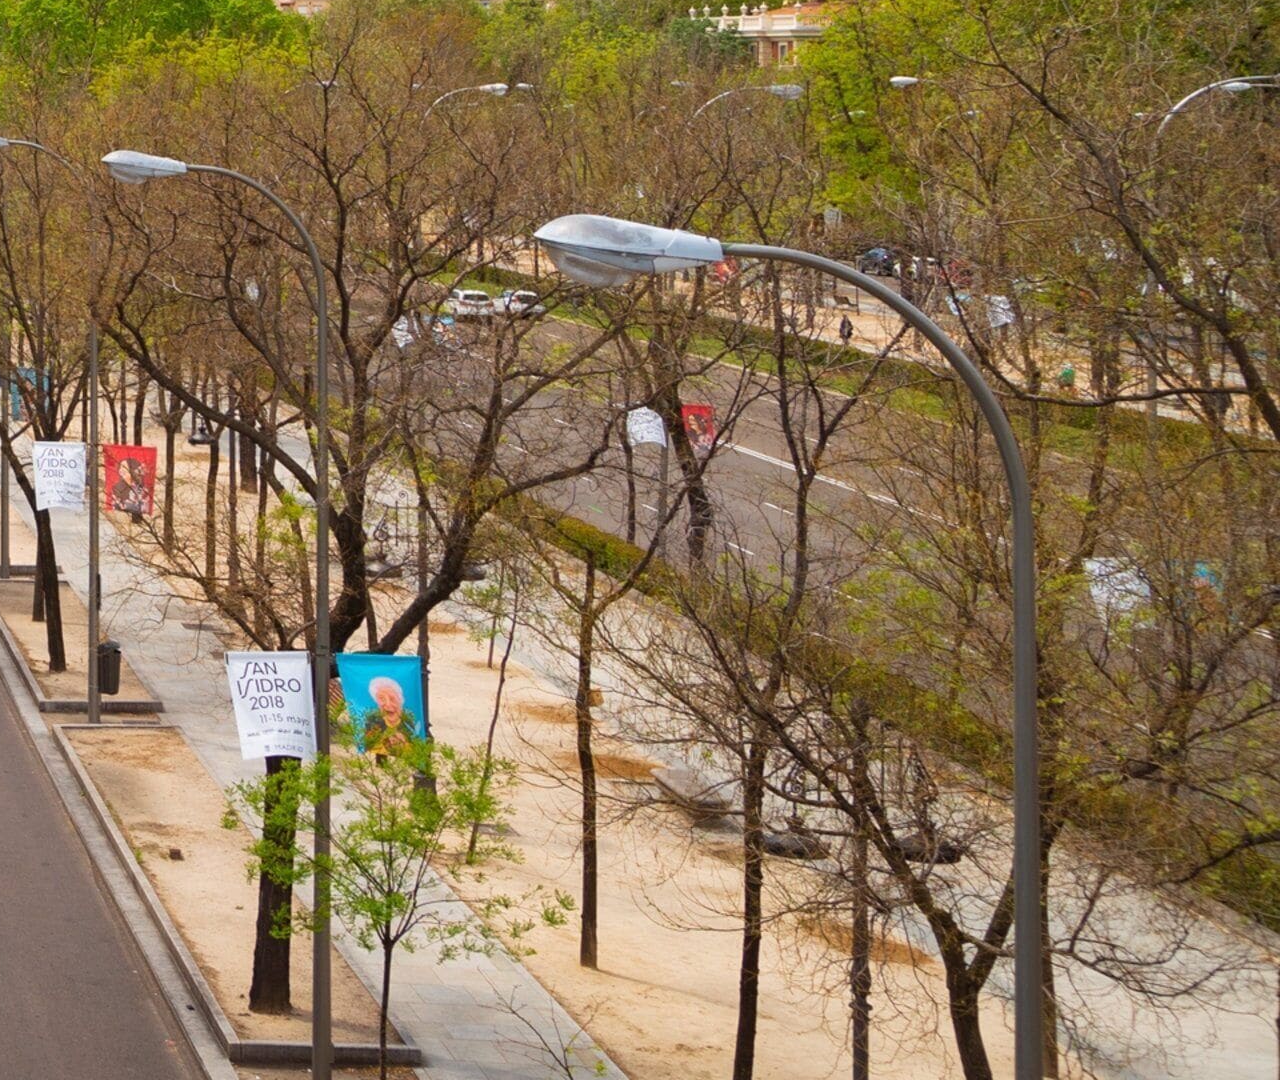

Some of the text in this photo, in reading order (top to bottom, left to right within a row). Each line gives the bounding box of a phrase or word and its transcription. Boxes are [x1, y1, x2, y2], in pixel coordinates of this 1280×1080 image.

[39, 448, 64, 459] SAN
[37, 458, 77, 471] ISIDRO
[42, 469, 65, 478] 2018
[239, 661, 278, 679] SAN
[236, 678, 301, 699] ISIDRO
[249, 695, 285, 710] 2018
[259, 713, 310, 727] 11-15 mayo
